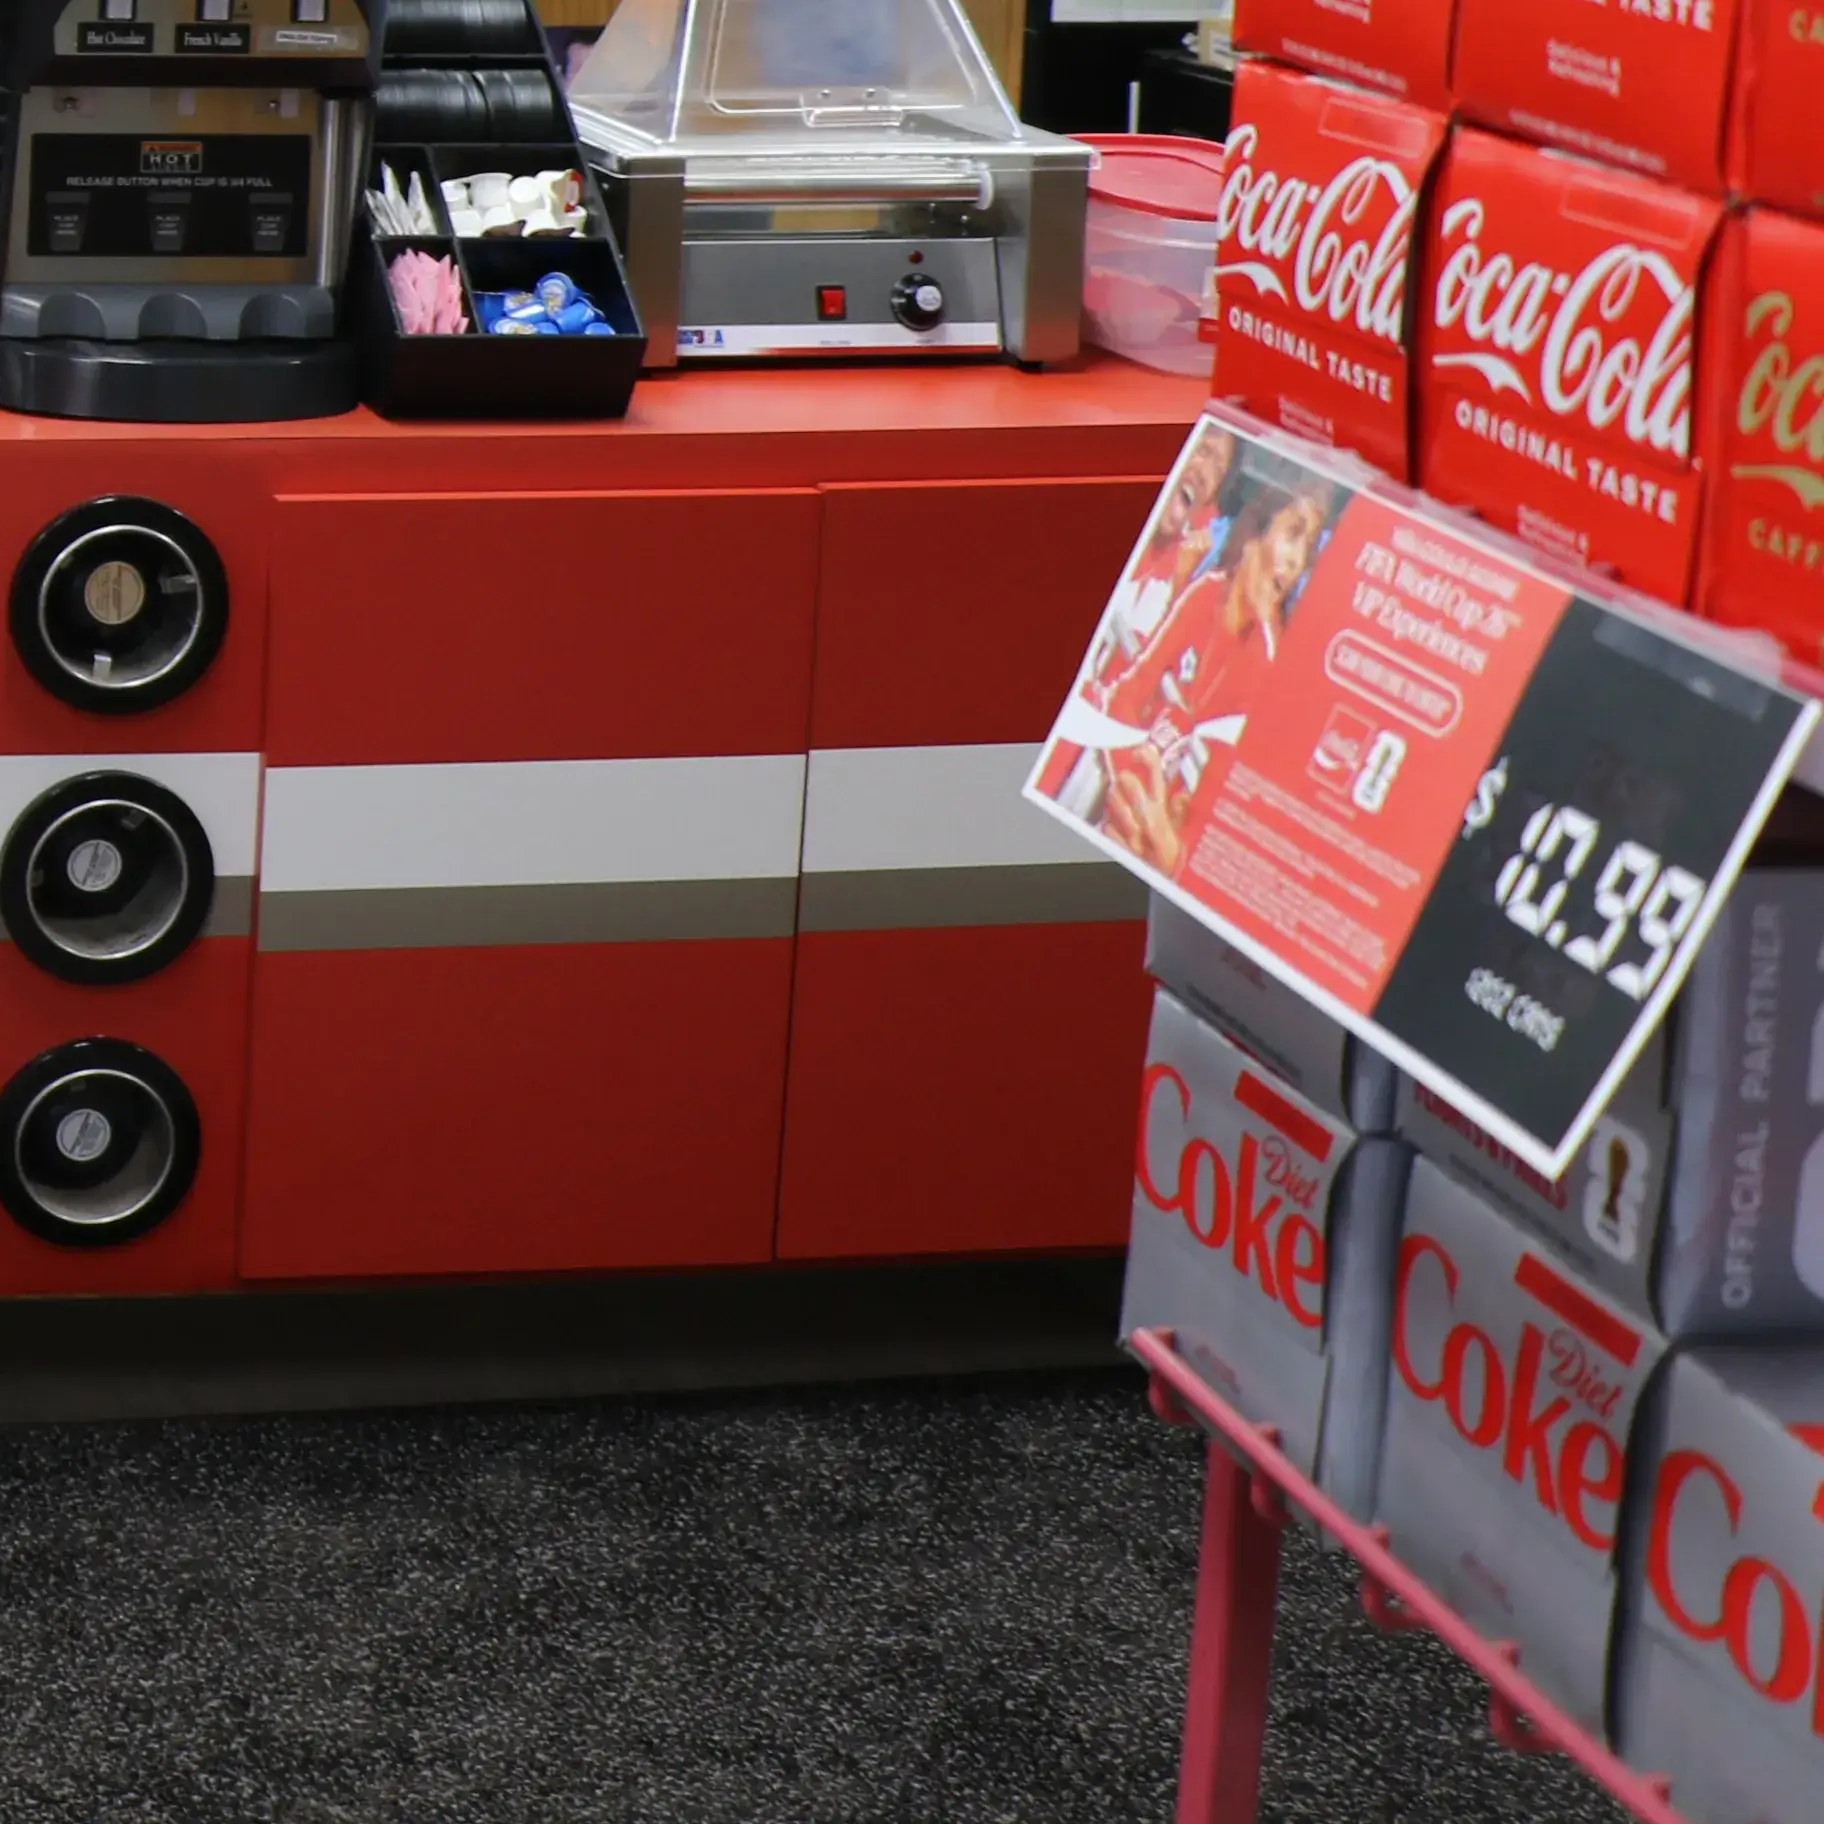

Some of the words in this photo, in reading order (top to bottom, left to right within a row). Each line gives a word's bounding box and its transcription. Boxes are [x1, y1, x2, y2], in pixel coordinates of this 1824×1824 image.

[87, 31, 104, 45] Hot
[66, 177, 114, 187] RELEASE
[116, 177, 159, 187] BUTTON
[161, 177, 192, 187] WHEN
[150, 153, 192, 164] HOT
[1217, 124, 1418, 346] Coca-Cola
[1229, 306, 1320, 369] ORIGINAL
[1326, 352, 1393, 403] TASTE
[1433, 199, 1696, 459] Coca-Cola
[1456, 398, 1579, 480] ORIGINAL
[1587, 455, 1679, 526] TASTE
[1462, 755, 1509, 840] $
[1494, 801, 1708, 1003] 10.99
[1739, 902, 1785, 1103] PARTNER
[1135, 1063, 1326, 1329] Coke
[1262, 1134, 1317, 1210] Diet
[1720, 1119, 1770, 1310] OFFICIAL
[1392, 1233, 1626, 1553] Coke
[1544, 1326, 1619, 1419] Diet
[1646, 1448, 1824, 1744] Co
